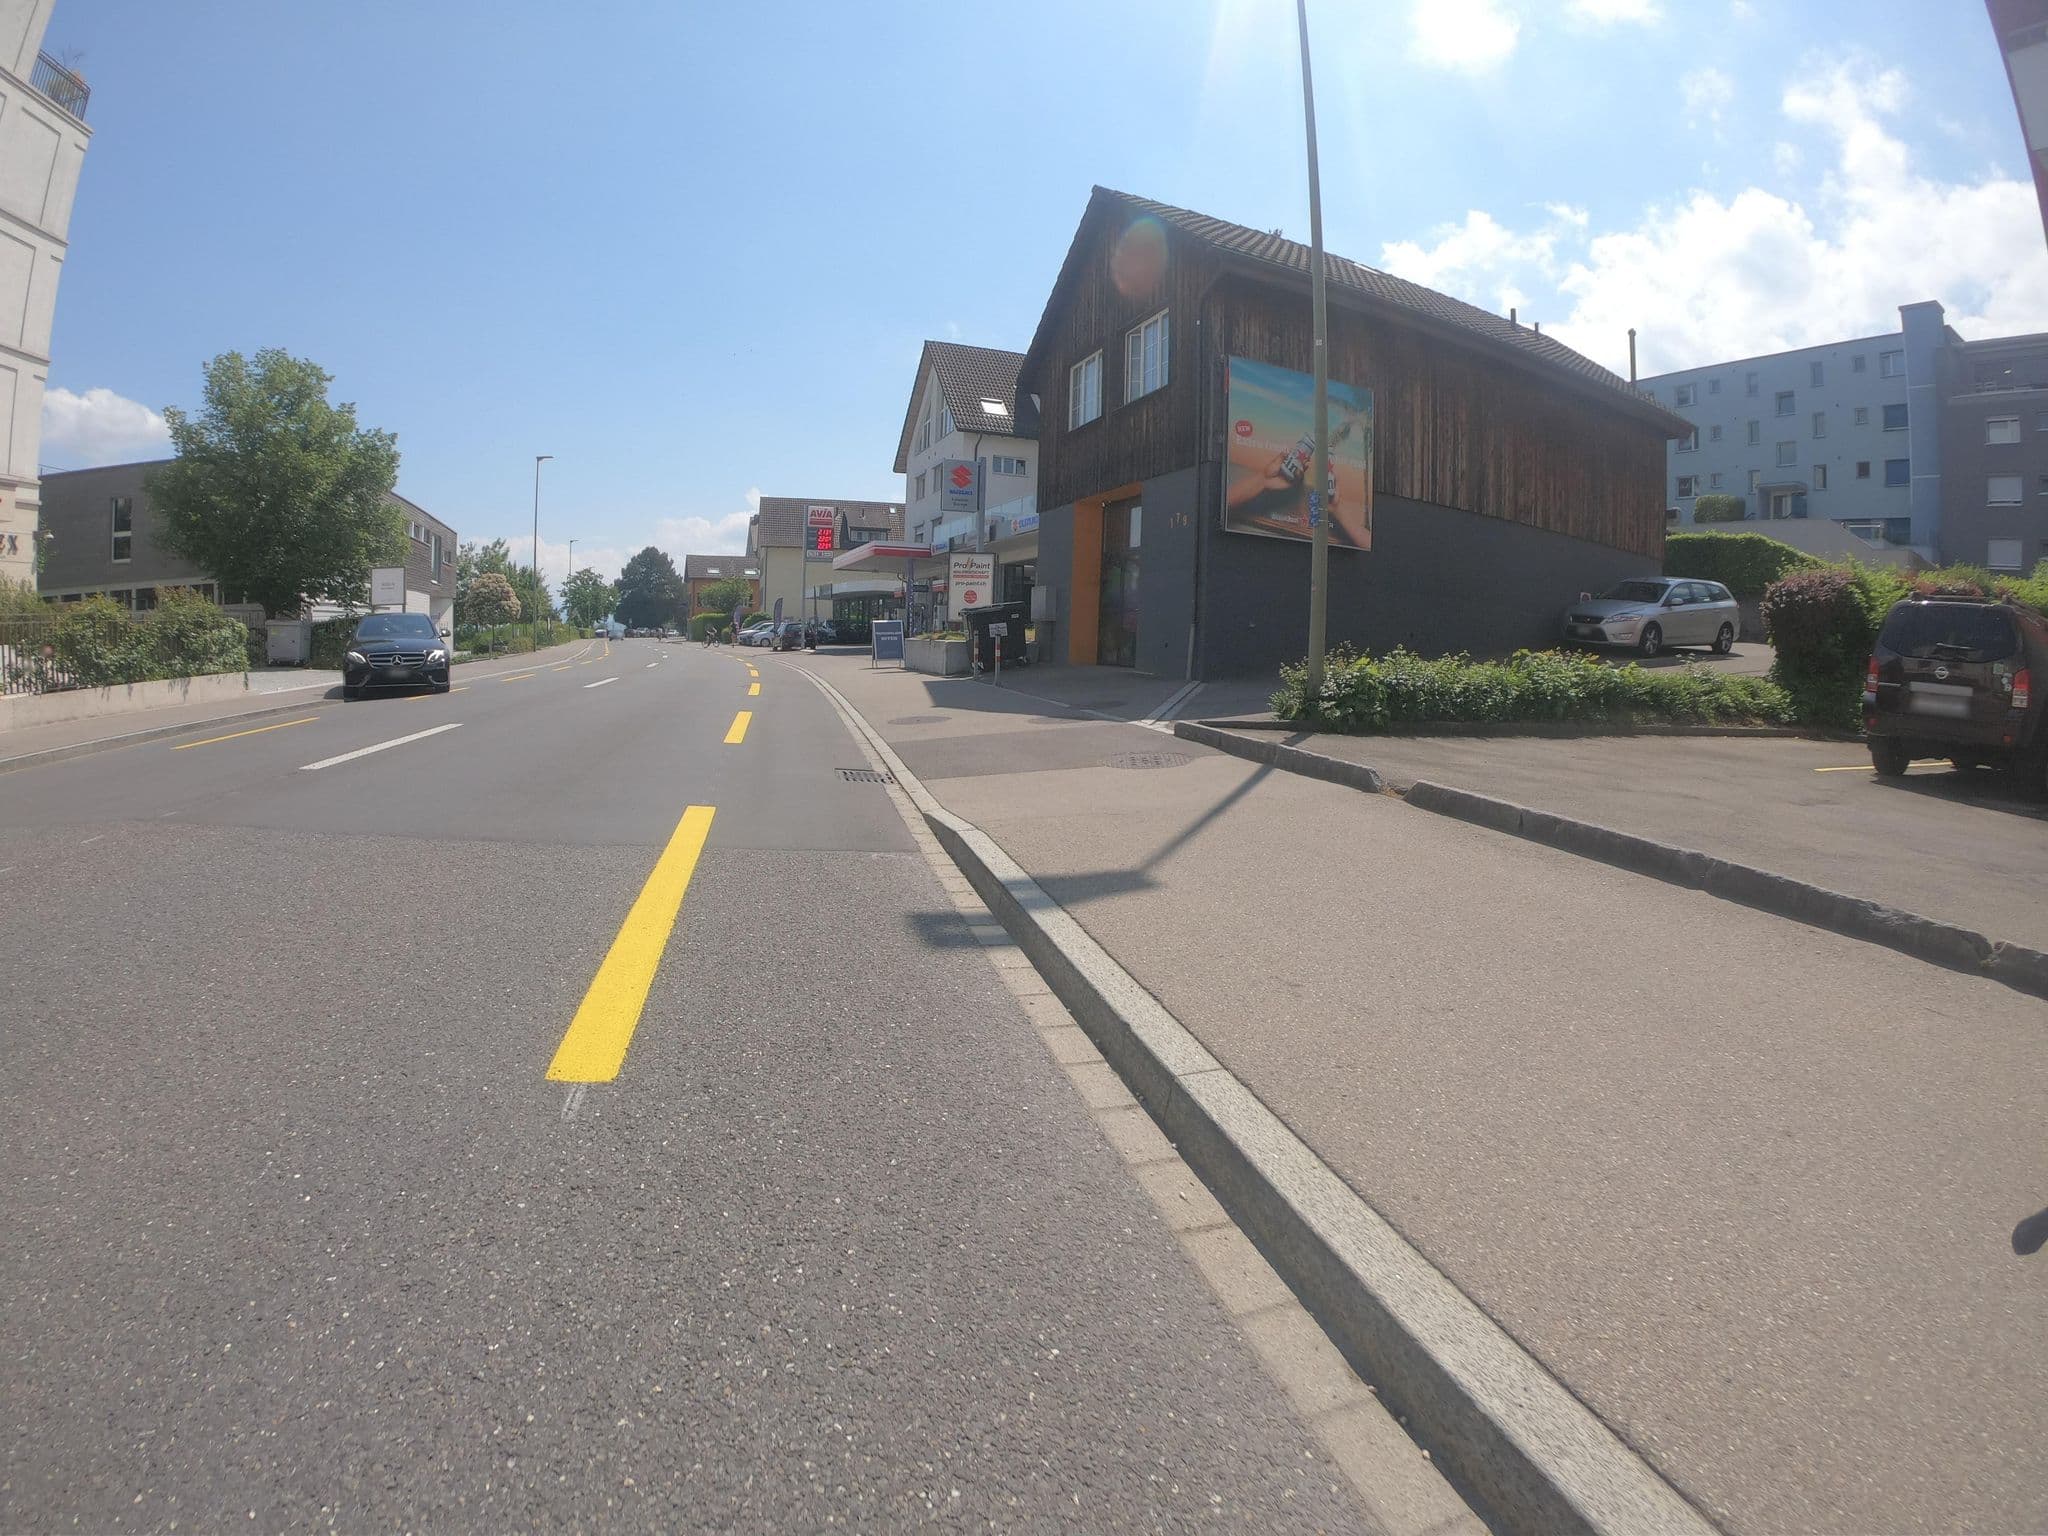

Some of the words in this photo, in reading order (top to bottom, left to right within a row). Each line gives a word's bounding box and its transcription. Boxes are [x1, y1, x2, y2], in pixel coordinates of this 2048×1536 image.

[810, 508, 832, 518] AVIA
[953, 561, 968, 569] Pro
[970, 561, 991, 569] Paint
